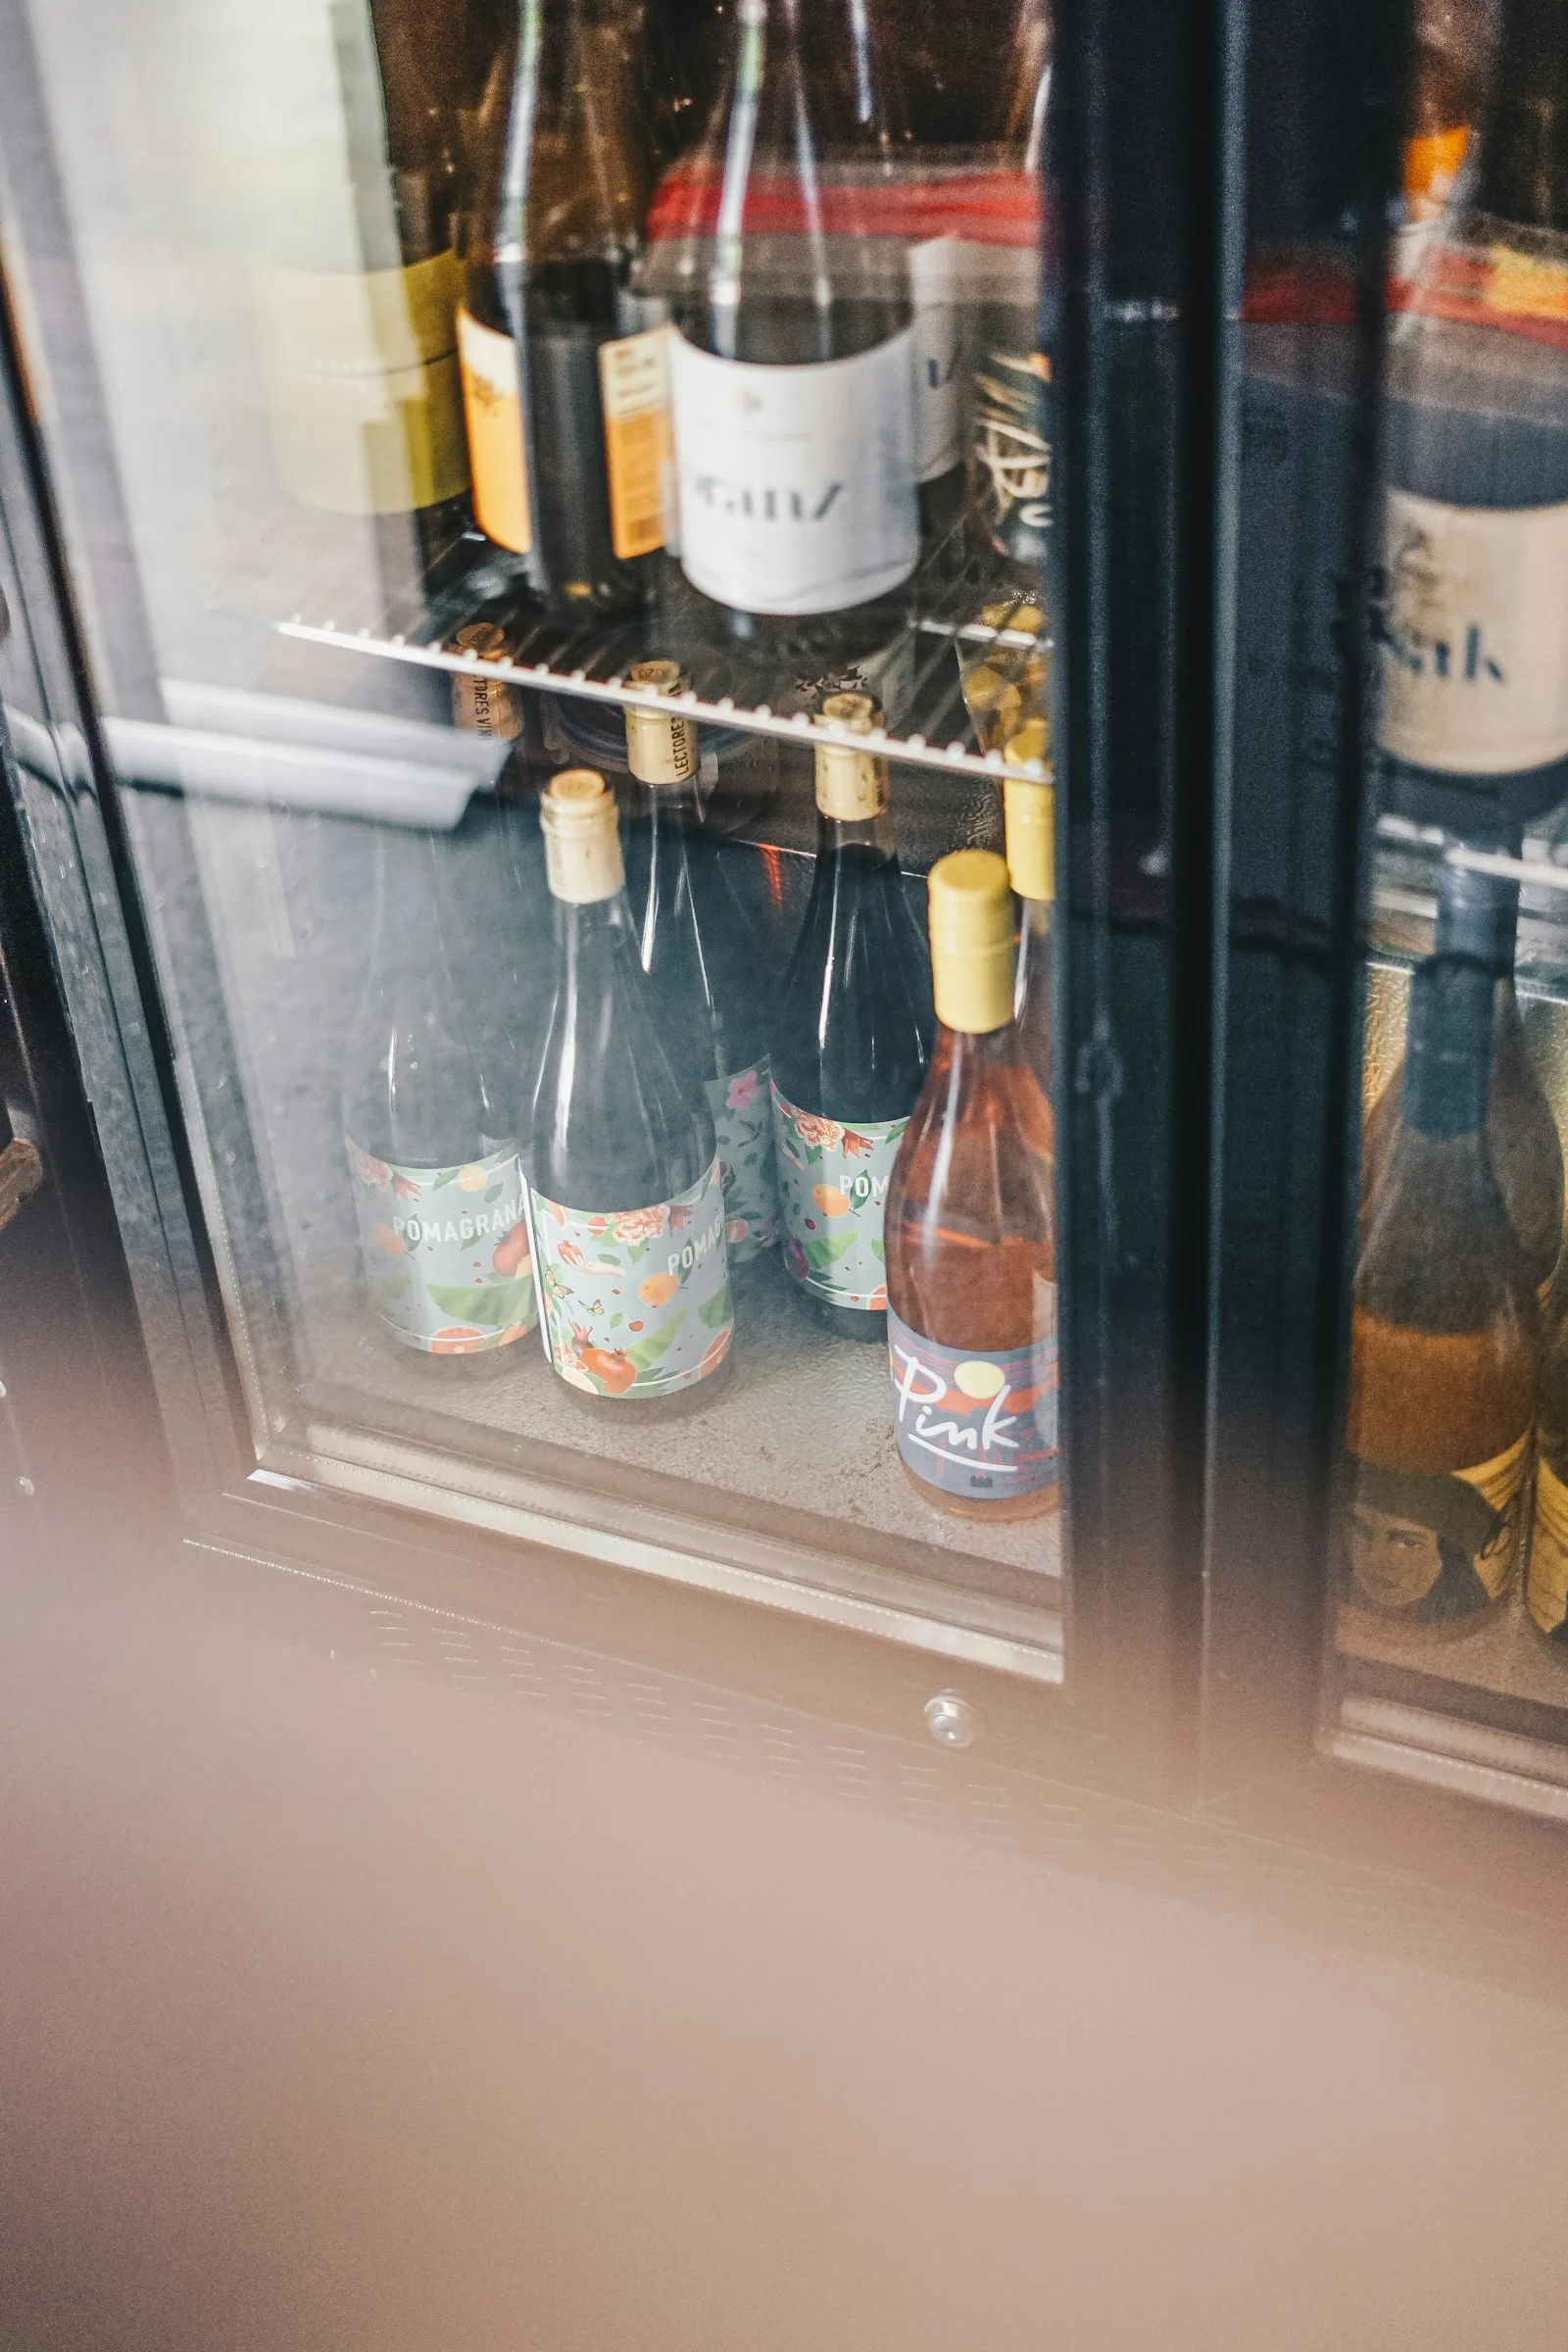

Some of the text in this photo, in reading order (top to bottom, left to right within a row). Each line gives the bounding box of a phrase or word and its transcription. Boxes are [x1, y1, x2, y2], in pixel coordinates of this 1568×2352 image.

[472, 674, 490, 715] TORES
[840, 1174, 889, 1198] POM
[894, 1344, 1020, 1450] Pink
